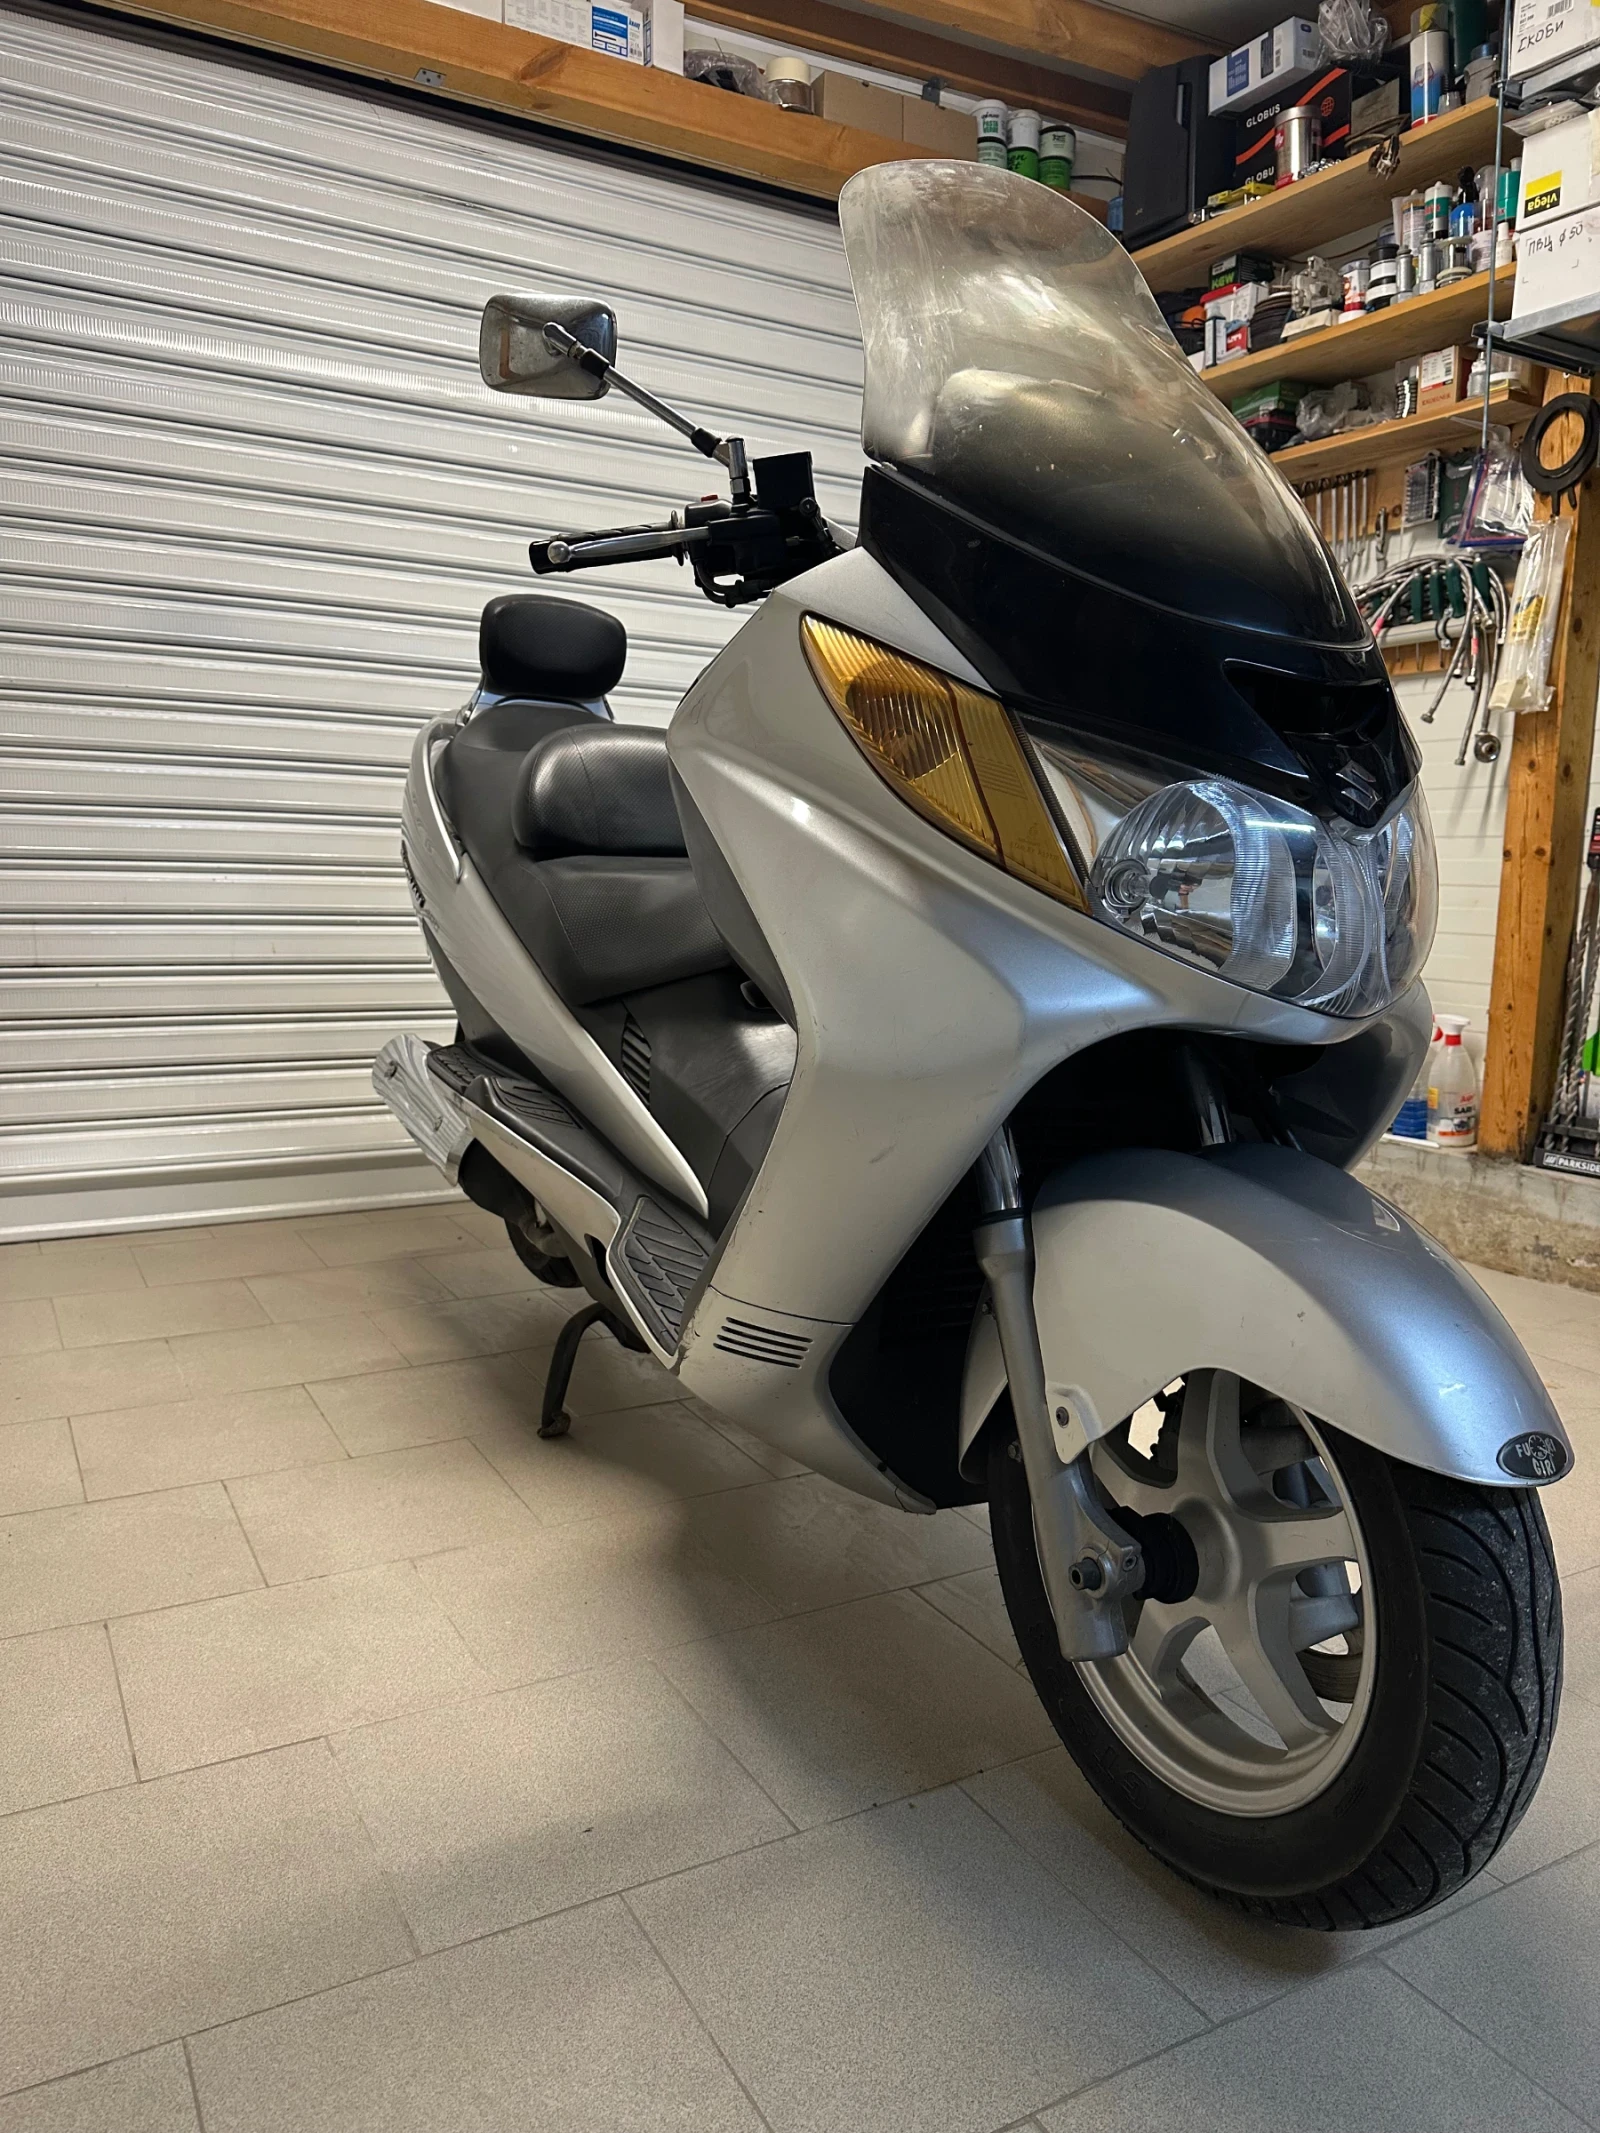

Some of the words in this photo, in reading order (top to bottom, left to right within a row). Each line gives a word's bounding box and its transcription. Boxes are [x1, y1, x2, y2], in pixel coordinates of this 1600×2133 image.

[1245, 103, 1281, 128] GLOBUS
[1245, 165, 1275, 187] GLOBU
[1527, 193, 1558, 211] viega
[1558, 1157, 1600, 1173] PARKSIDE
